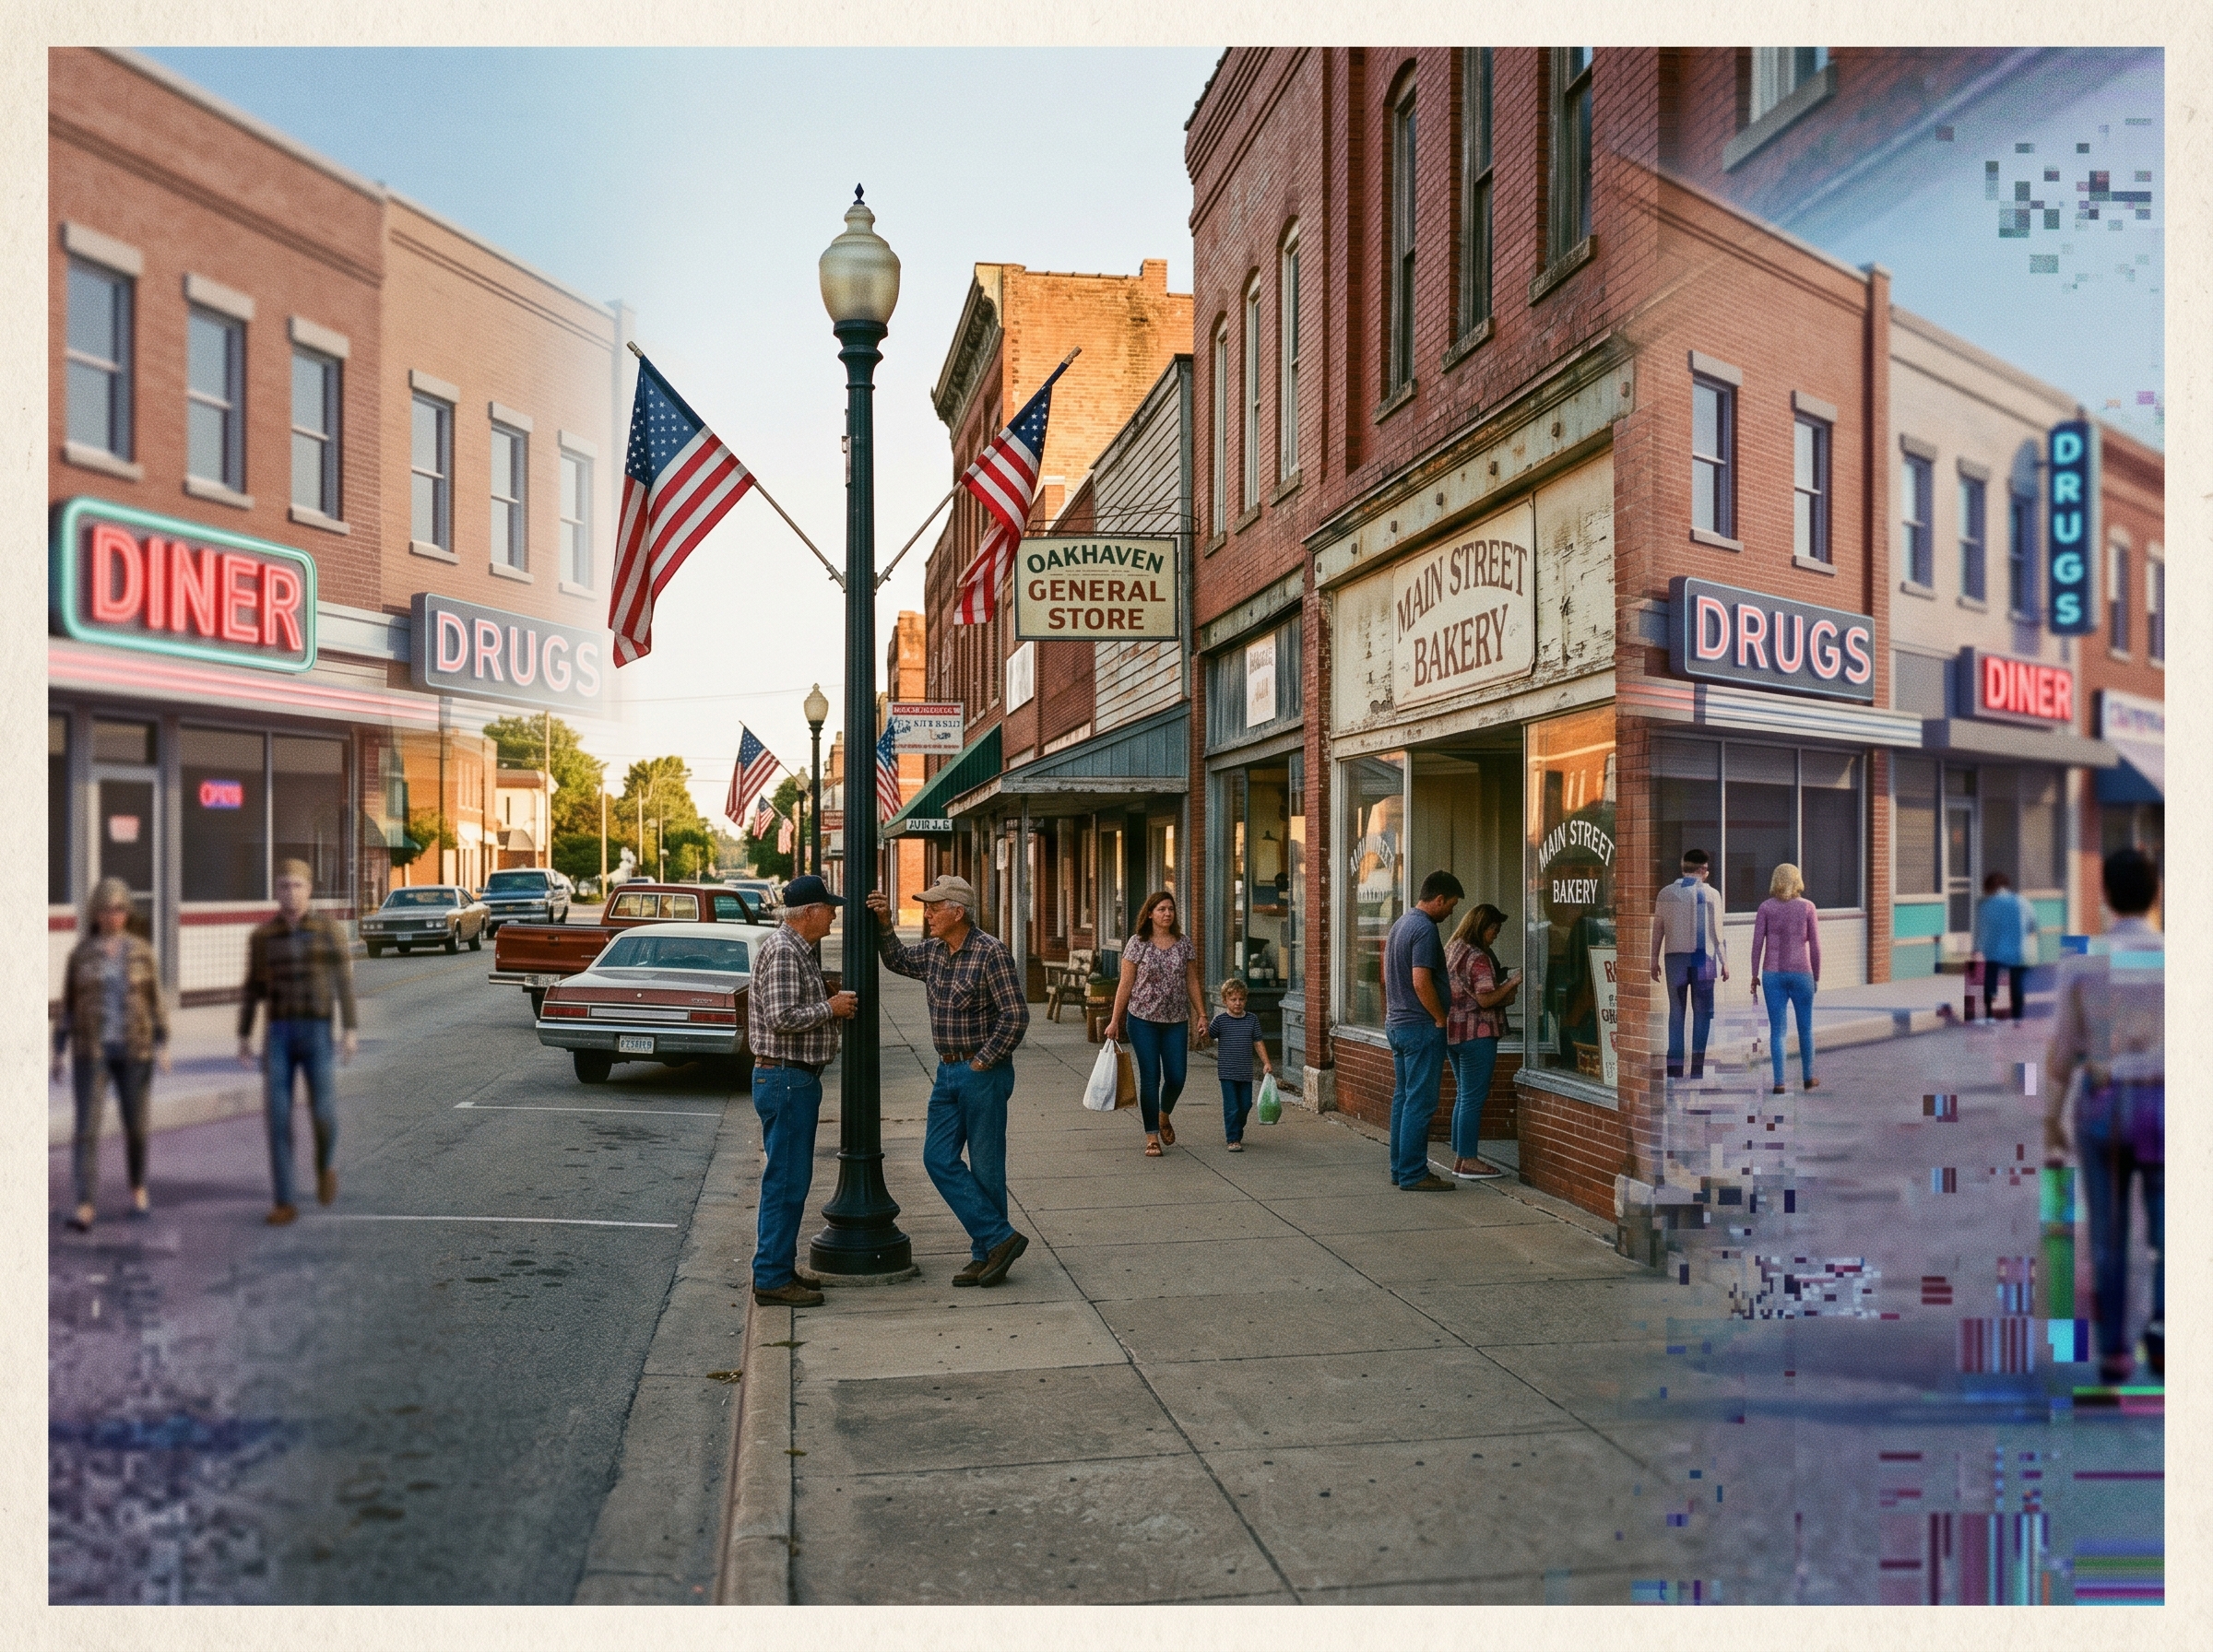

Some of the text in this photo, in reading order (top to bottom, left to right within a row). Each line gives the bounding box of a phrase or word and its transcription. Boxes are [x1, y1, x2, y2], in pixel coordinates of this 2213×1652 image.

[1026, 544, 1165, 574] OAKHAVEN
[2053, 431, 2084, 626] DRUGS
[94, 523, 303, 652] DINER
[1028, 580, 1166, 602] GENERAL
[1048, 608, 1144, 631] STORE
[1397, 539, 1528, 644] MAIN STREET
[437, 609, 601, 698] DRUGS
[1414, 603, 1509, 688] BAKERY
[1697, 595, 1872, 685] DRUGS
[1985, 655, 2074, 722] DINER
[1538, 820, 1615, 873] MAIN STREET
[1553, 879, 1598, 904] BAKERY
